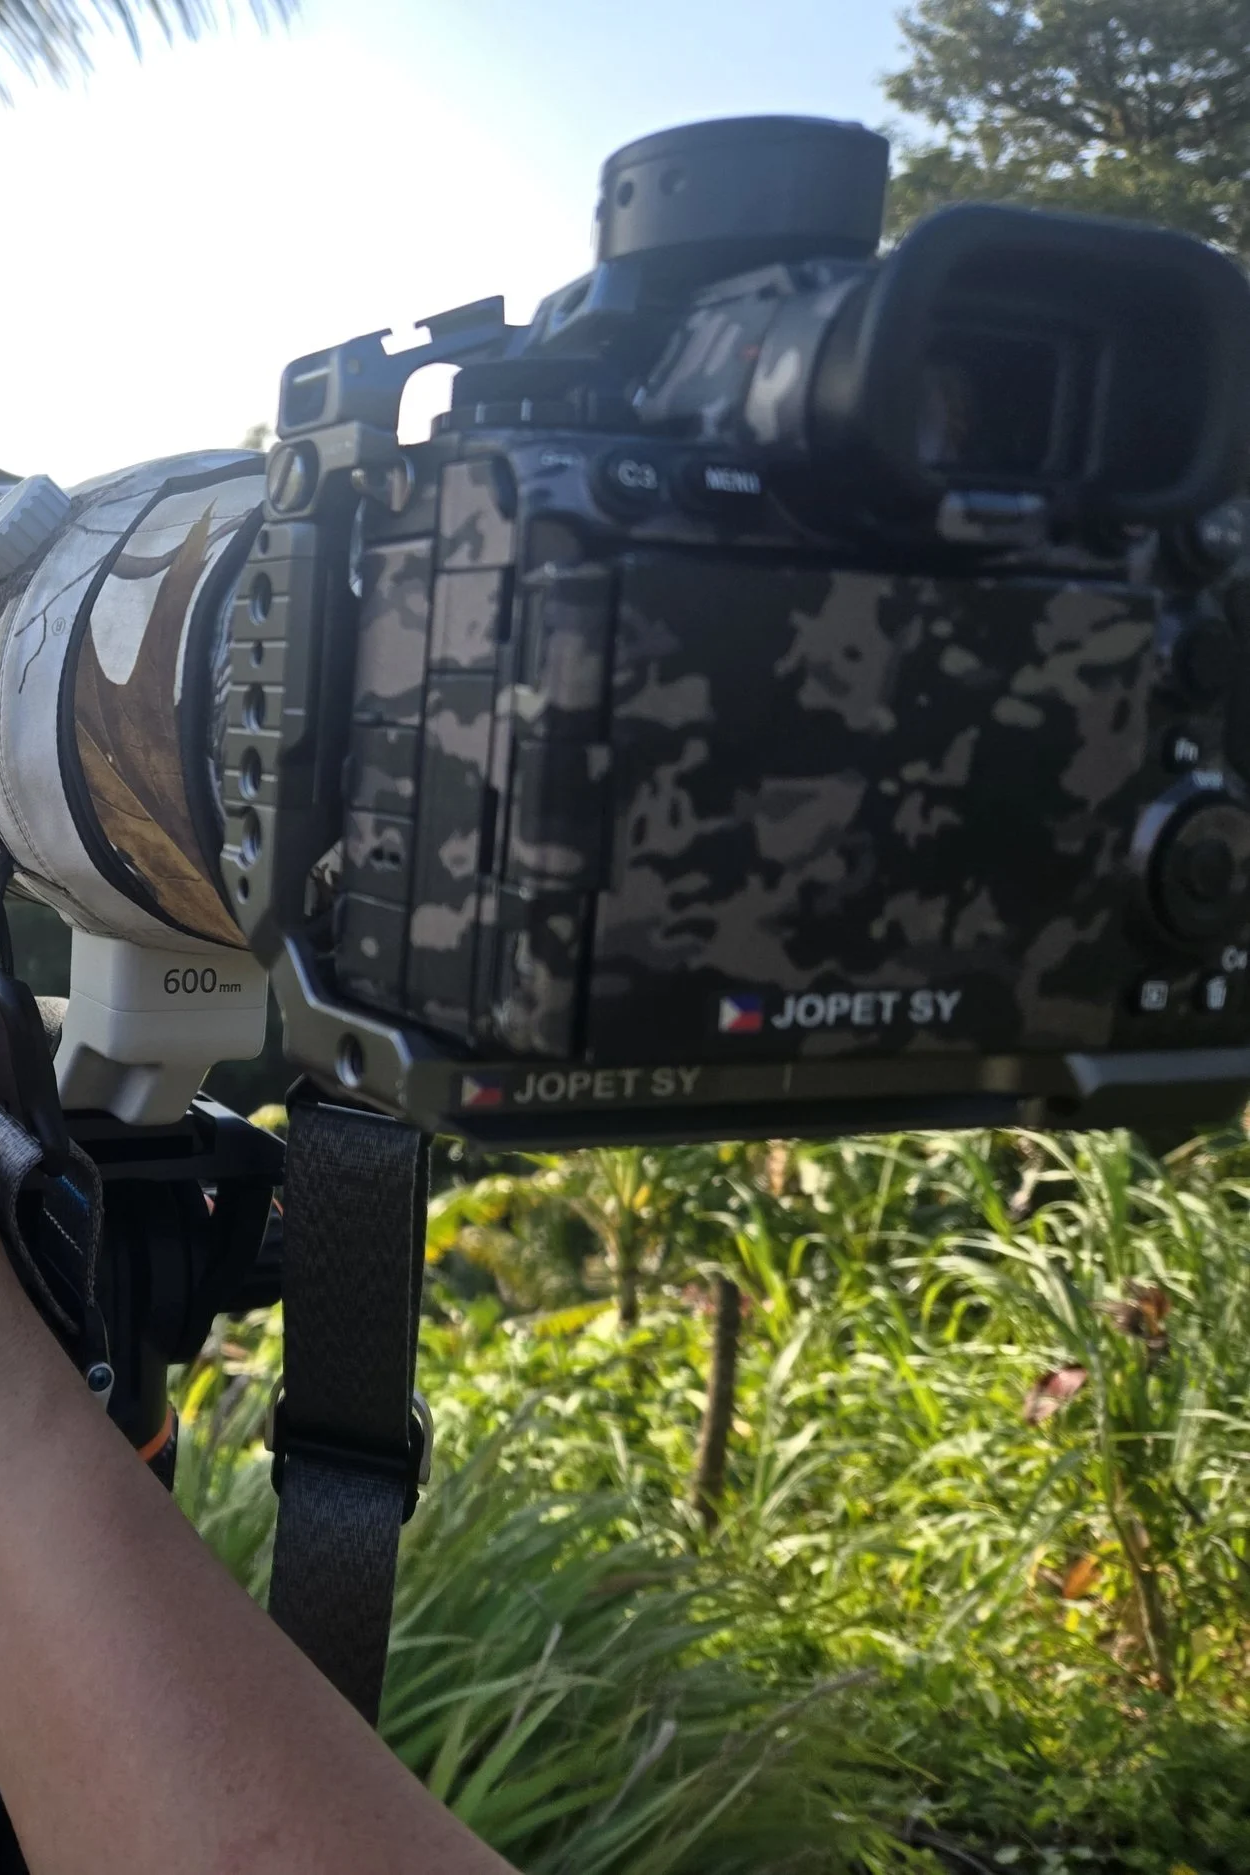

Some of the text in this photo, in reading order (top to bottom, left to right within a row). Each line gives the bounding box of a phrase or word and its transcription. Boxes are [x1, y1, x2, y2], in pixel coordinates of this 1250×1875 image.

[704, 464, 761, 494] MENU
[770, 988, 962, 1030] JOPET SY
[513, 1065, 702, 1104] JOPET SY
